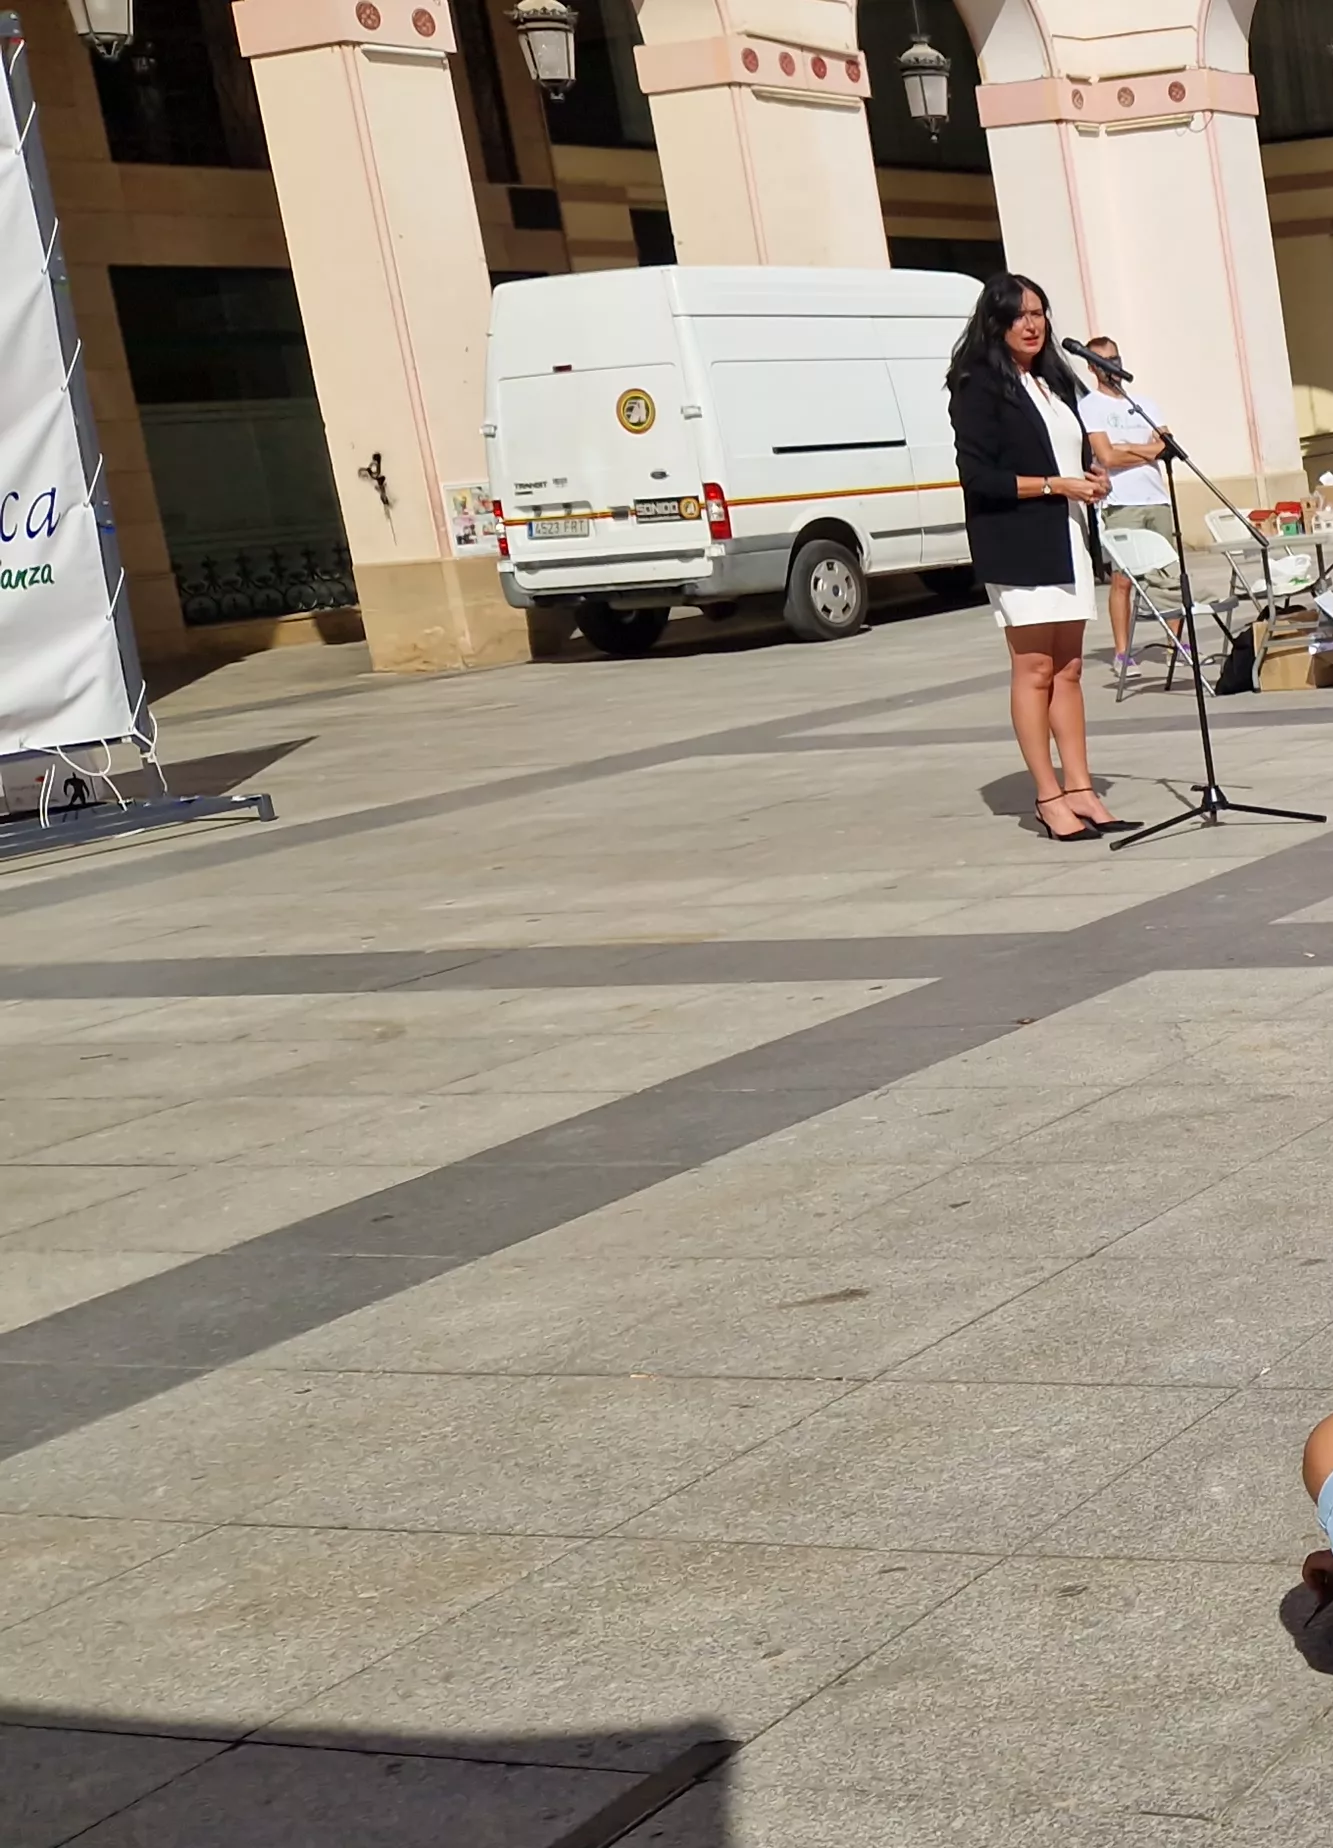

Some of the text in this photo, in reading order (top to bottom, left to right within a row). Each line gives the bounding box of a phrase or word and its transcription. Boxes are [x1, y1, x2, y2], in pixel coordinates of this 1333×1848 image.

[636, 501, 679, 516] SONIDO
[535, 520, 585, 535] 4523 FRT
